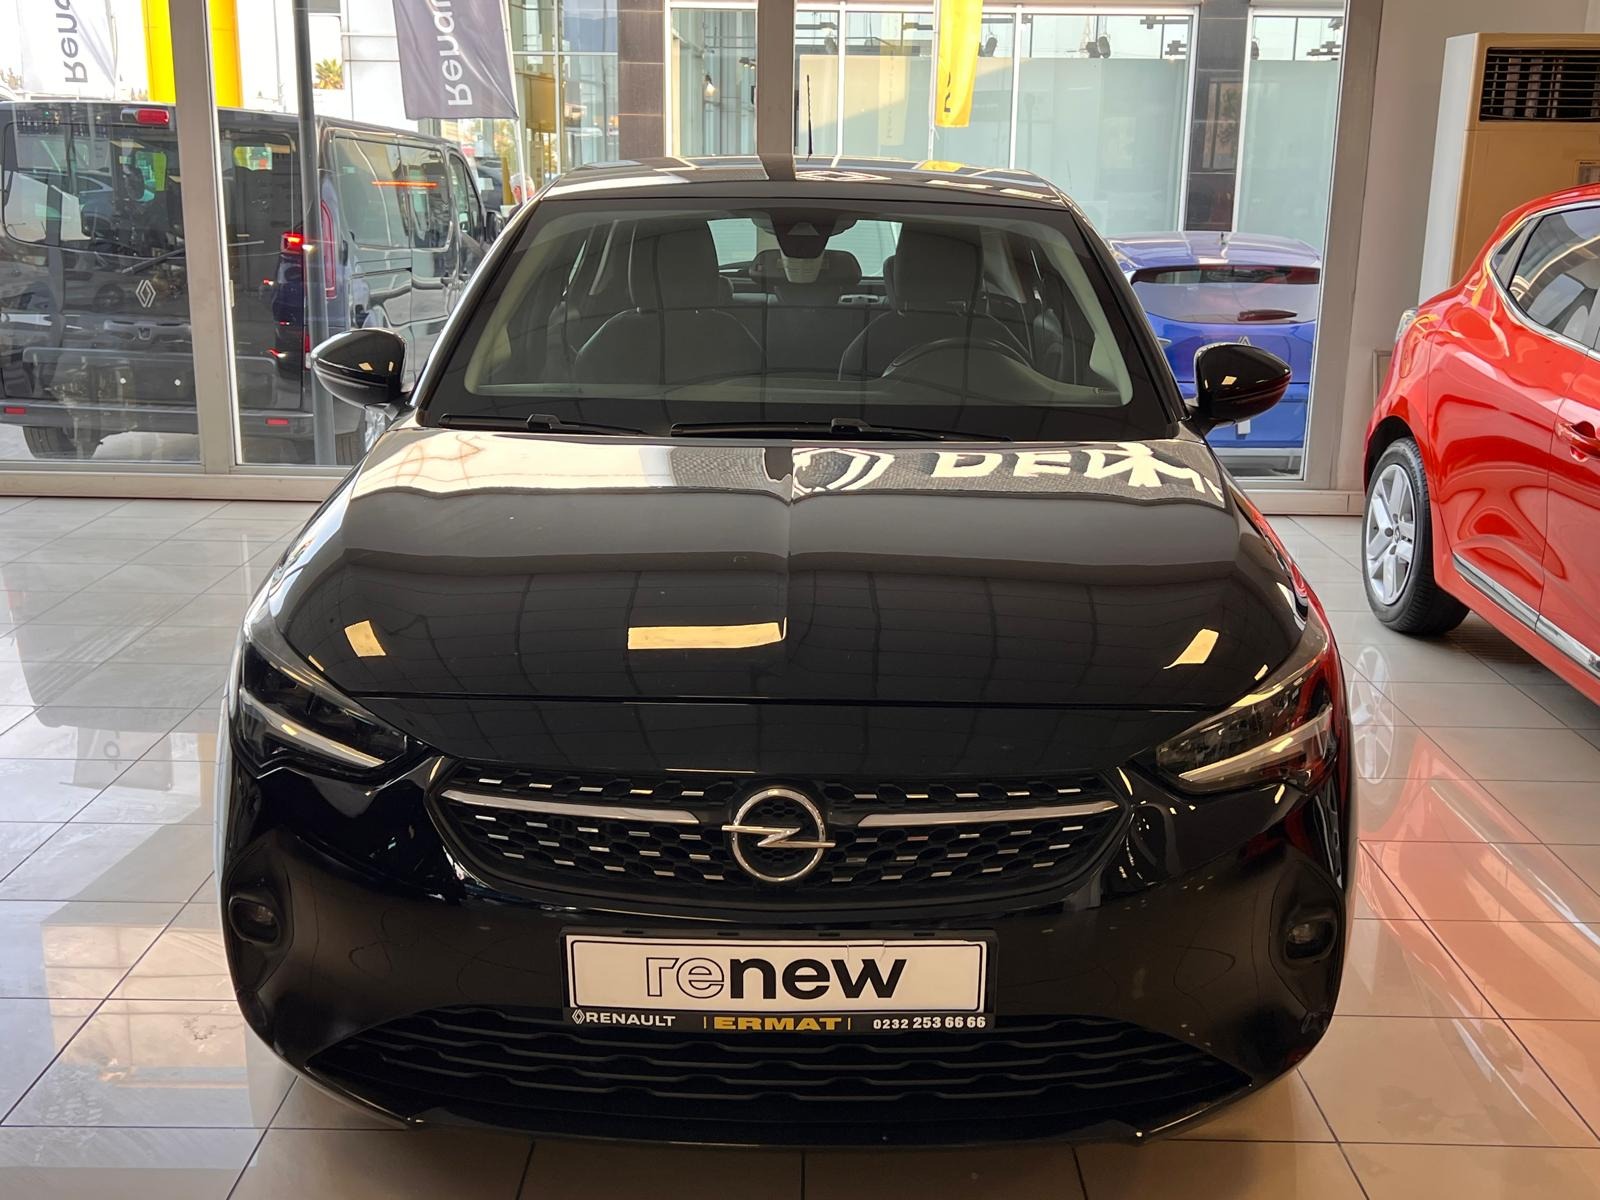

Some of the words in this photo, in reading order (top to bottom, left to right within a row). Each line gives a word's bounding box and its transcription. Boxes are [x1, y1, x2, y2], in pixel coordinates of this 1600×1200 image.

[646, 957, 907, 1000] renew
[586, 1012, 676, 1027] RENAULT
[713, 1016, 842, 1031] ERMAT
[873, 1018, 909, 1030] 0232
[912, 1016, 942, 1029] 253
